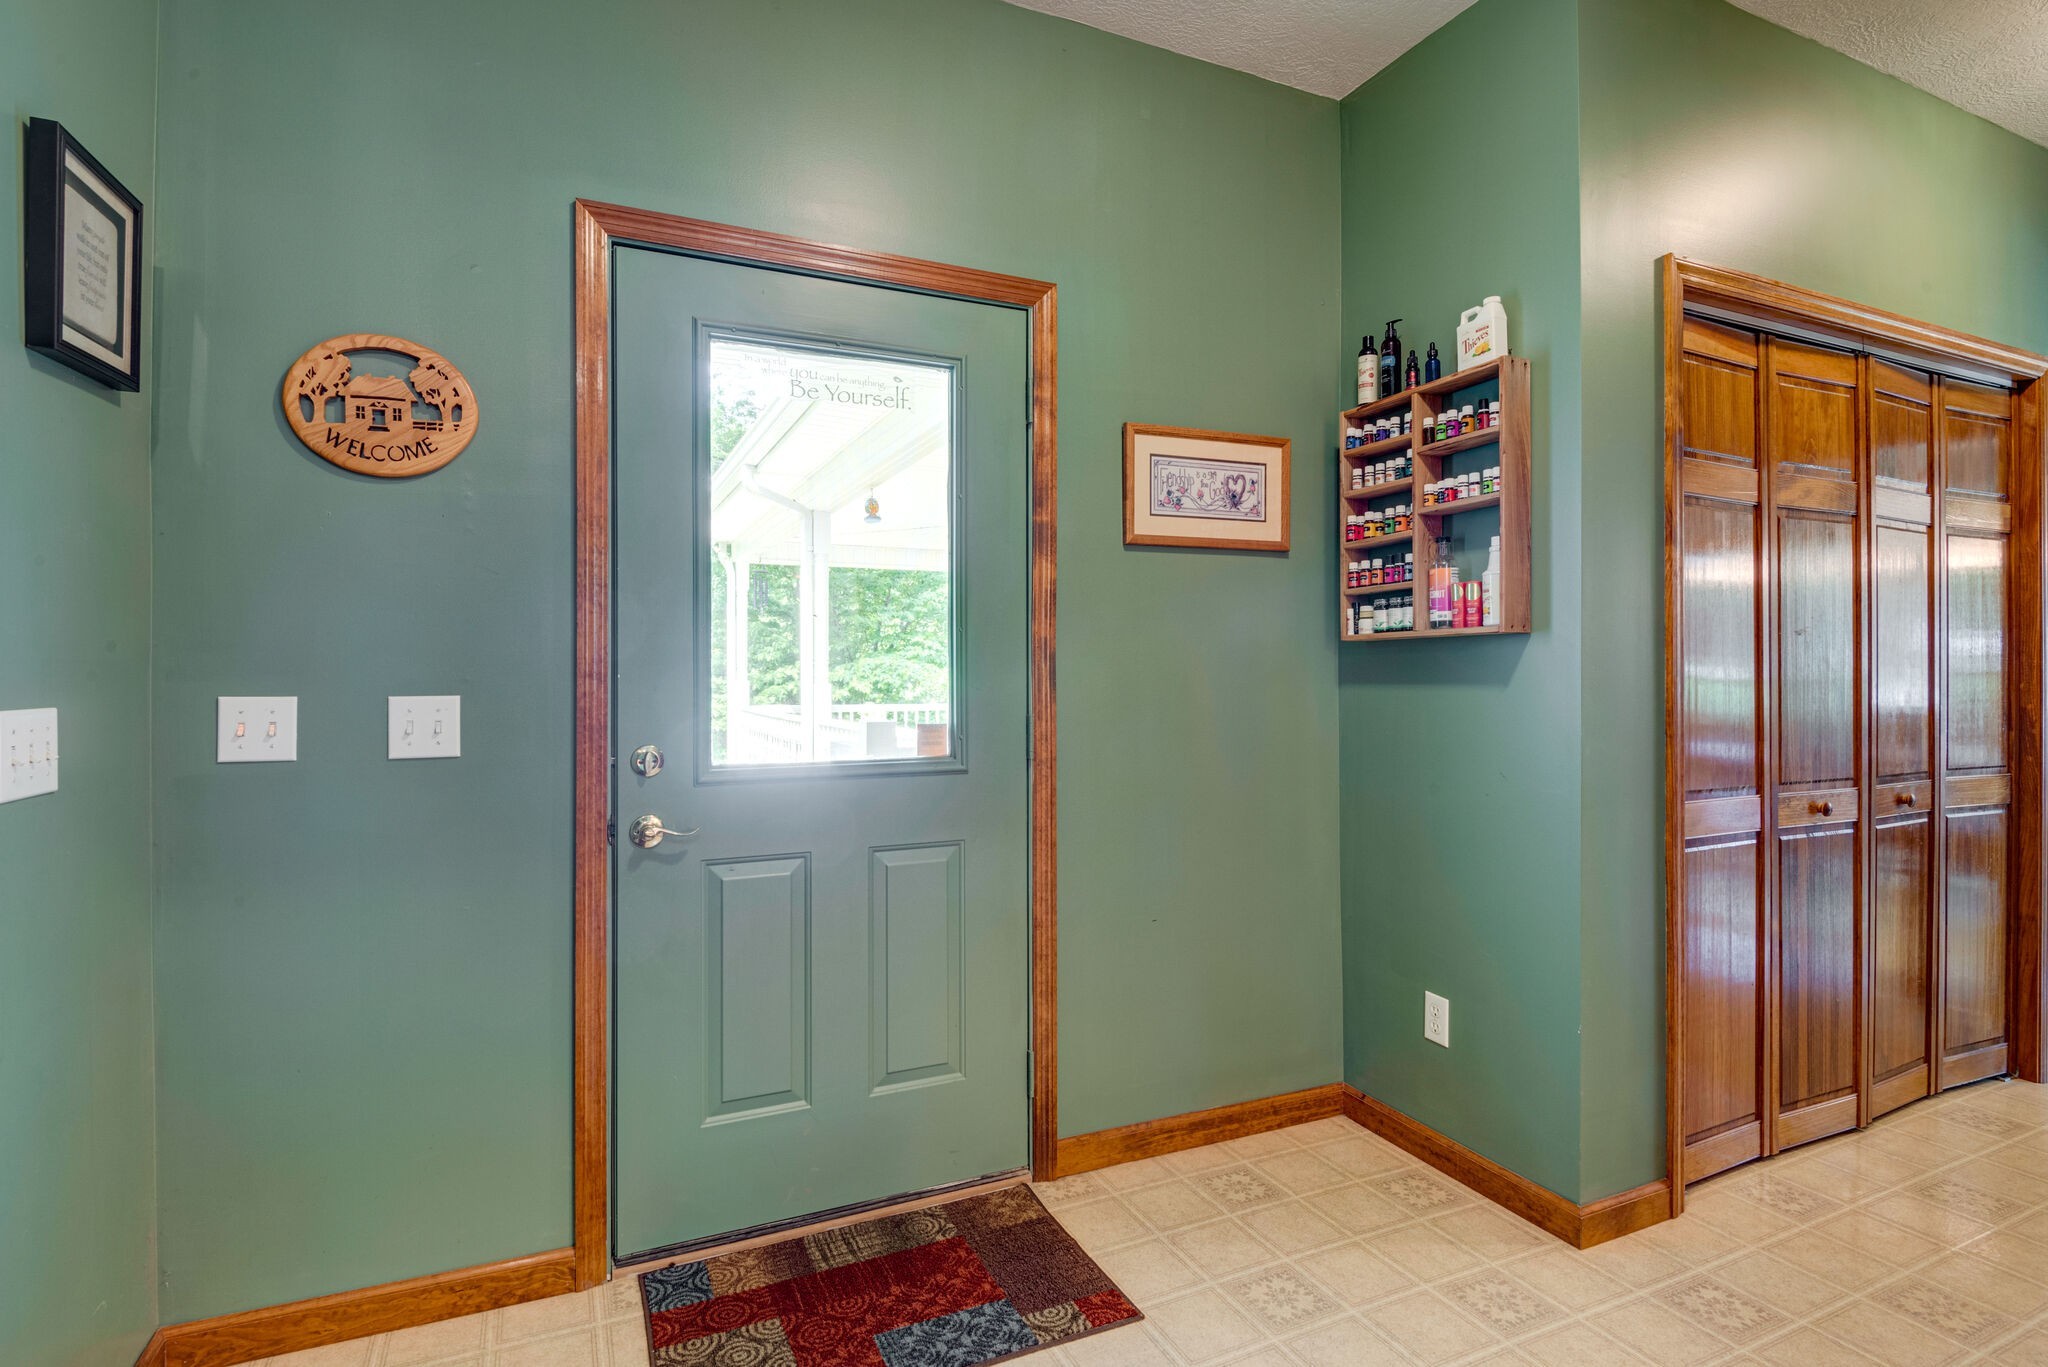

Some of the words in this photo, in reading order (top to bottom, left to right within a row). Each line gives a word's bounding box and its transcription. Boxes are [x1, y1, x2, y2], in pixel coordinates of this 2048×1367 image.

[1461, 330, 1489, 355] Thieves
[789, 367, 818, 380] you
[819, 374, 836, 383] can
[836, 373, 848, 383] be
[790, 380, 820, 400] Be
[825, 384, 912, 410] Yourself.
[325, 427, 439, 462] WELCOME
